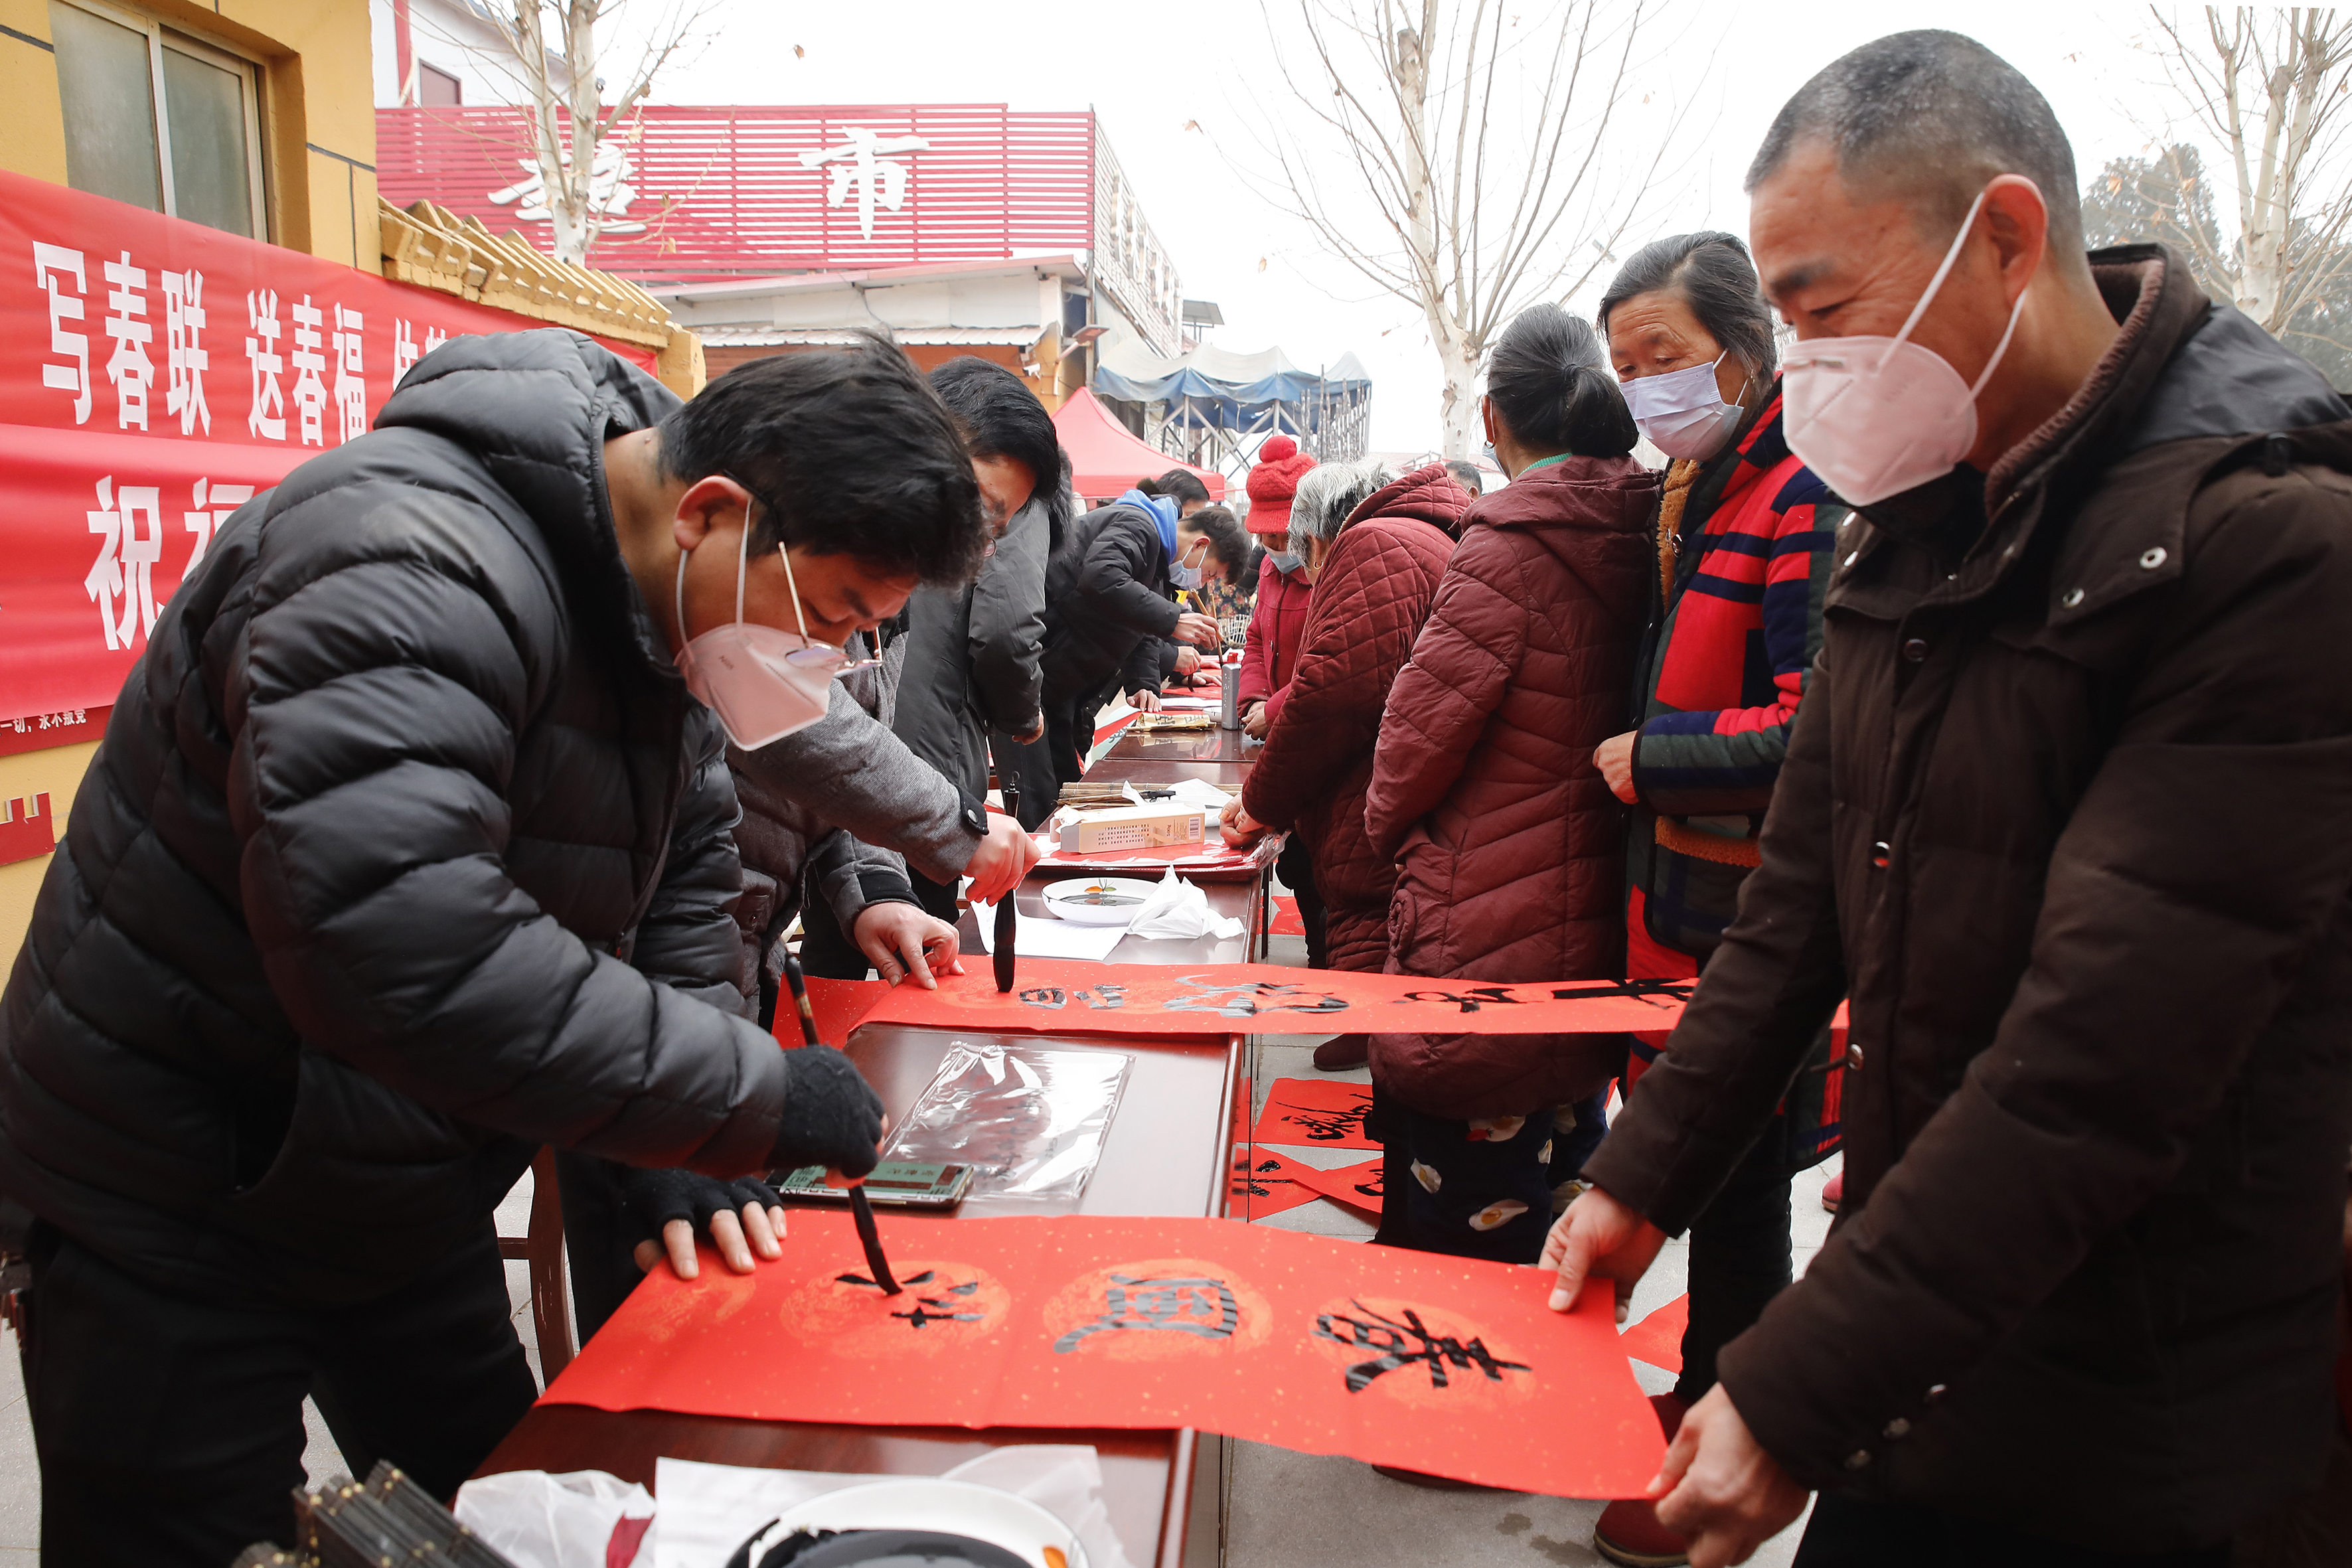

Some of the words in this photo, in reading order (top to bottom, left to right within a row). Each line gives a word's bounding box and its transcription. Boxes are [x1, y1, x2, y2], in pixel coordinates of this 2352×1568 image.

[33, 240, 211, 437] 写春联
[245, 288, 367, 446] 送春福
